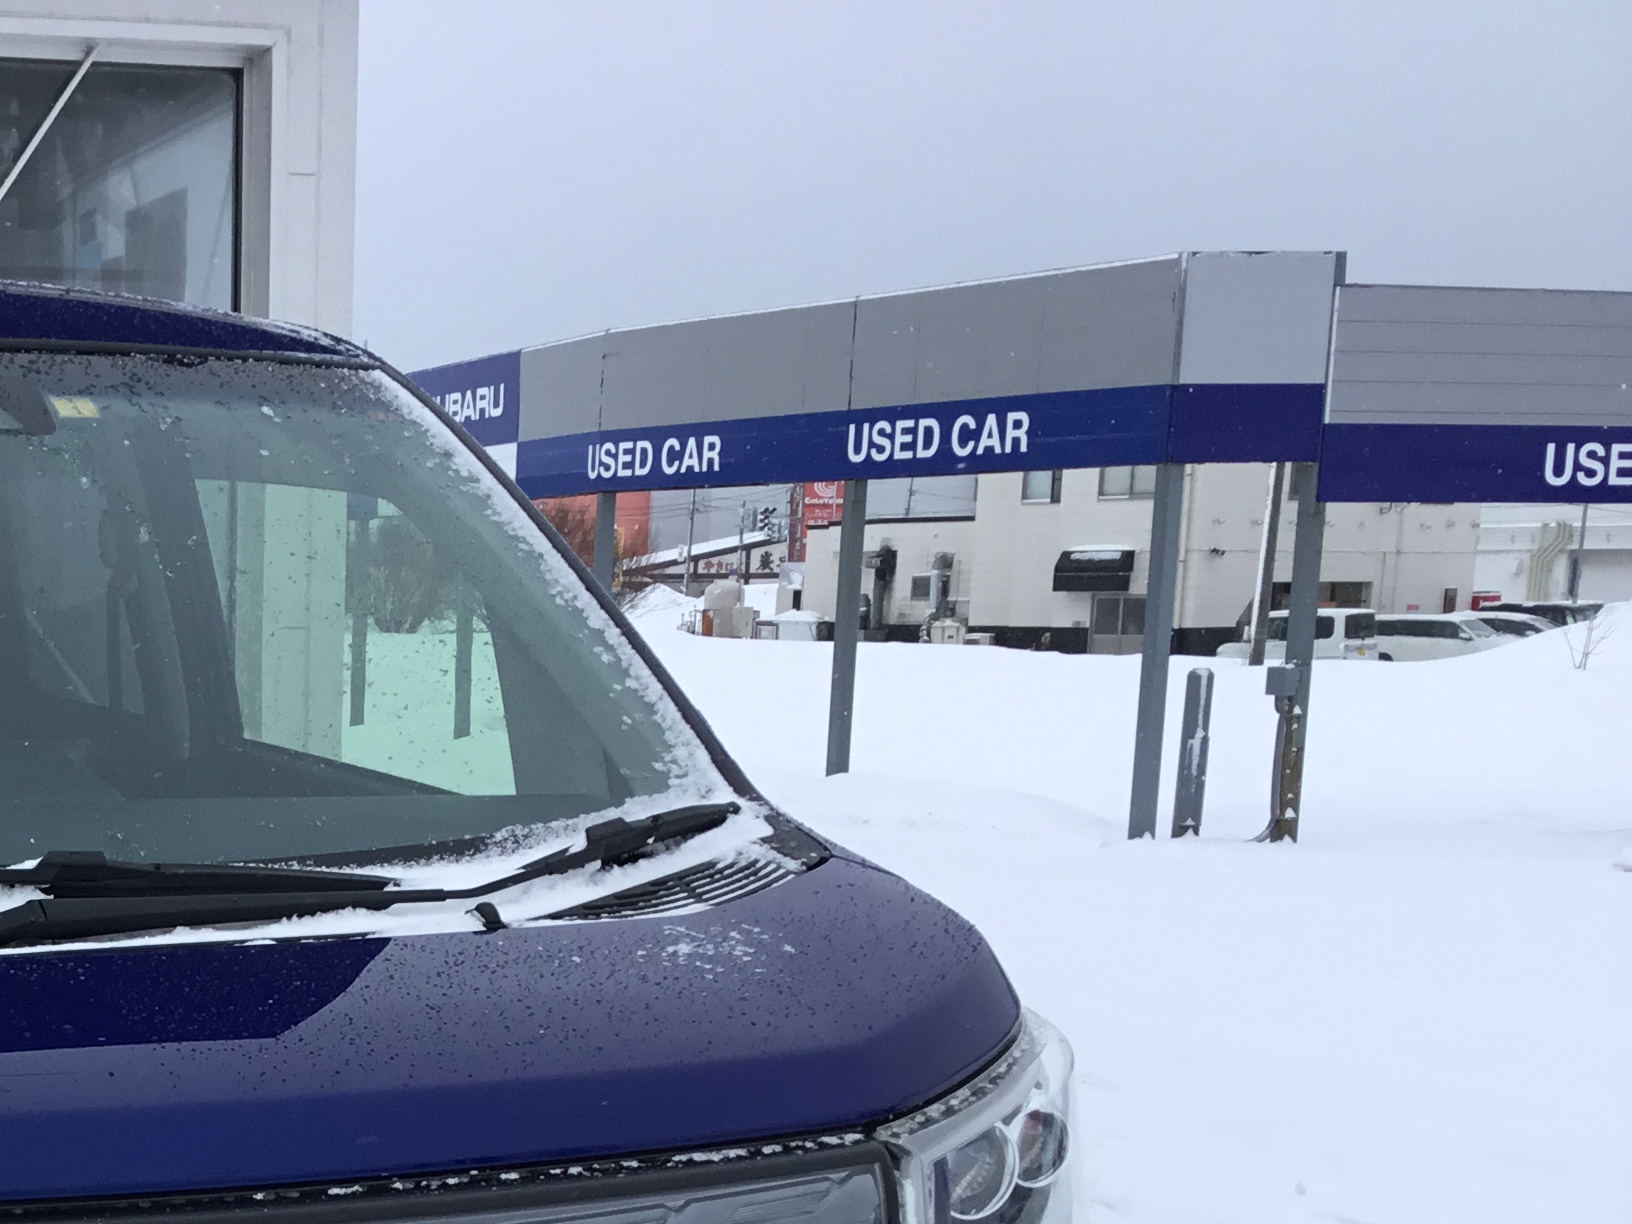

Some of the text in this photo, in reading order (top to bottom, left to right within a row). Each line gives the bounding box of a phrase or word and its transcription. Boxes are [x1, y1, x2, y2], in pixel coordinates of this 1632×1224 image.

[433, 382, 505, 423] BARU
[587, 435, 721, 479] USED CAR
[847, 411, 1030, 463] USED CAR
